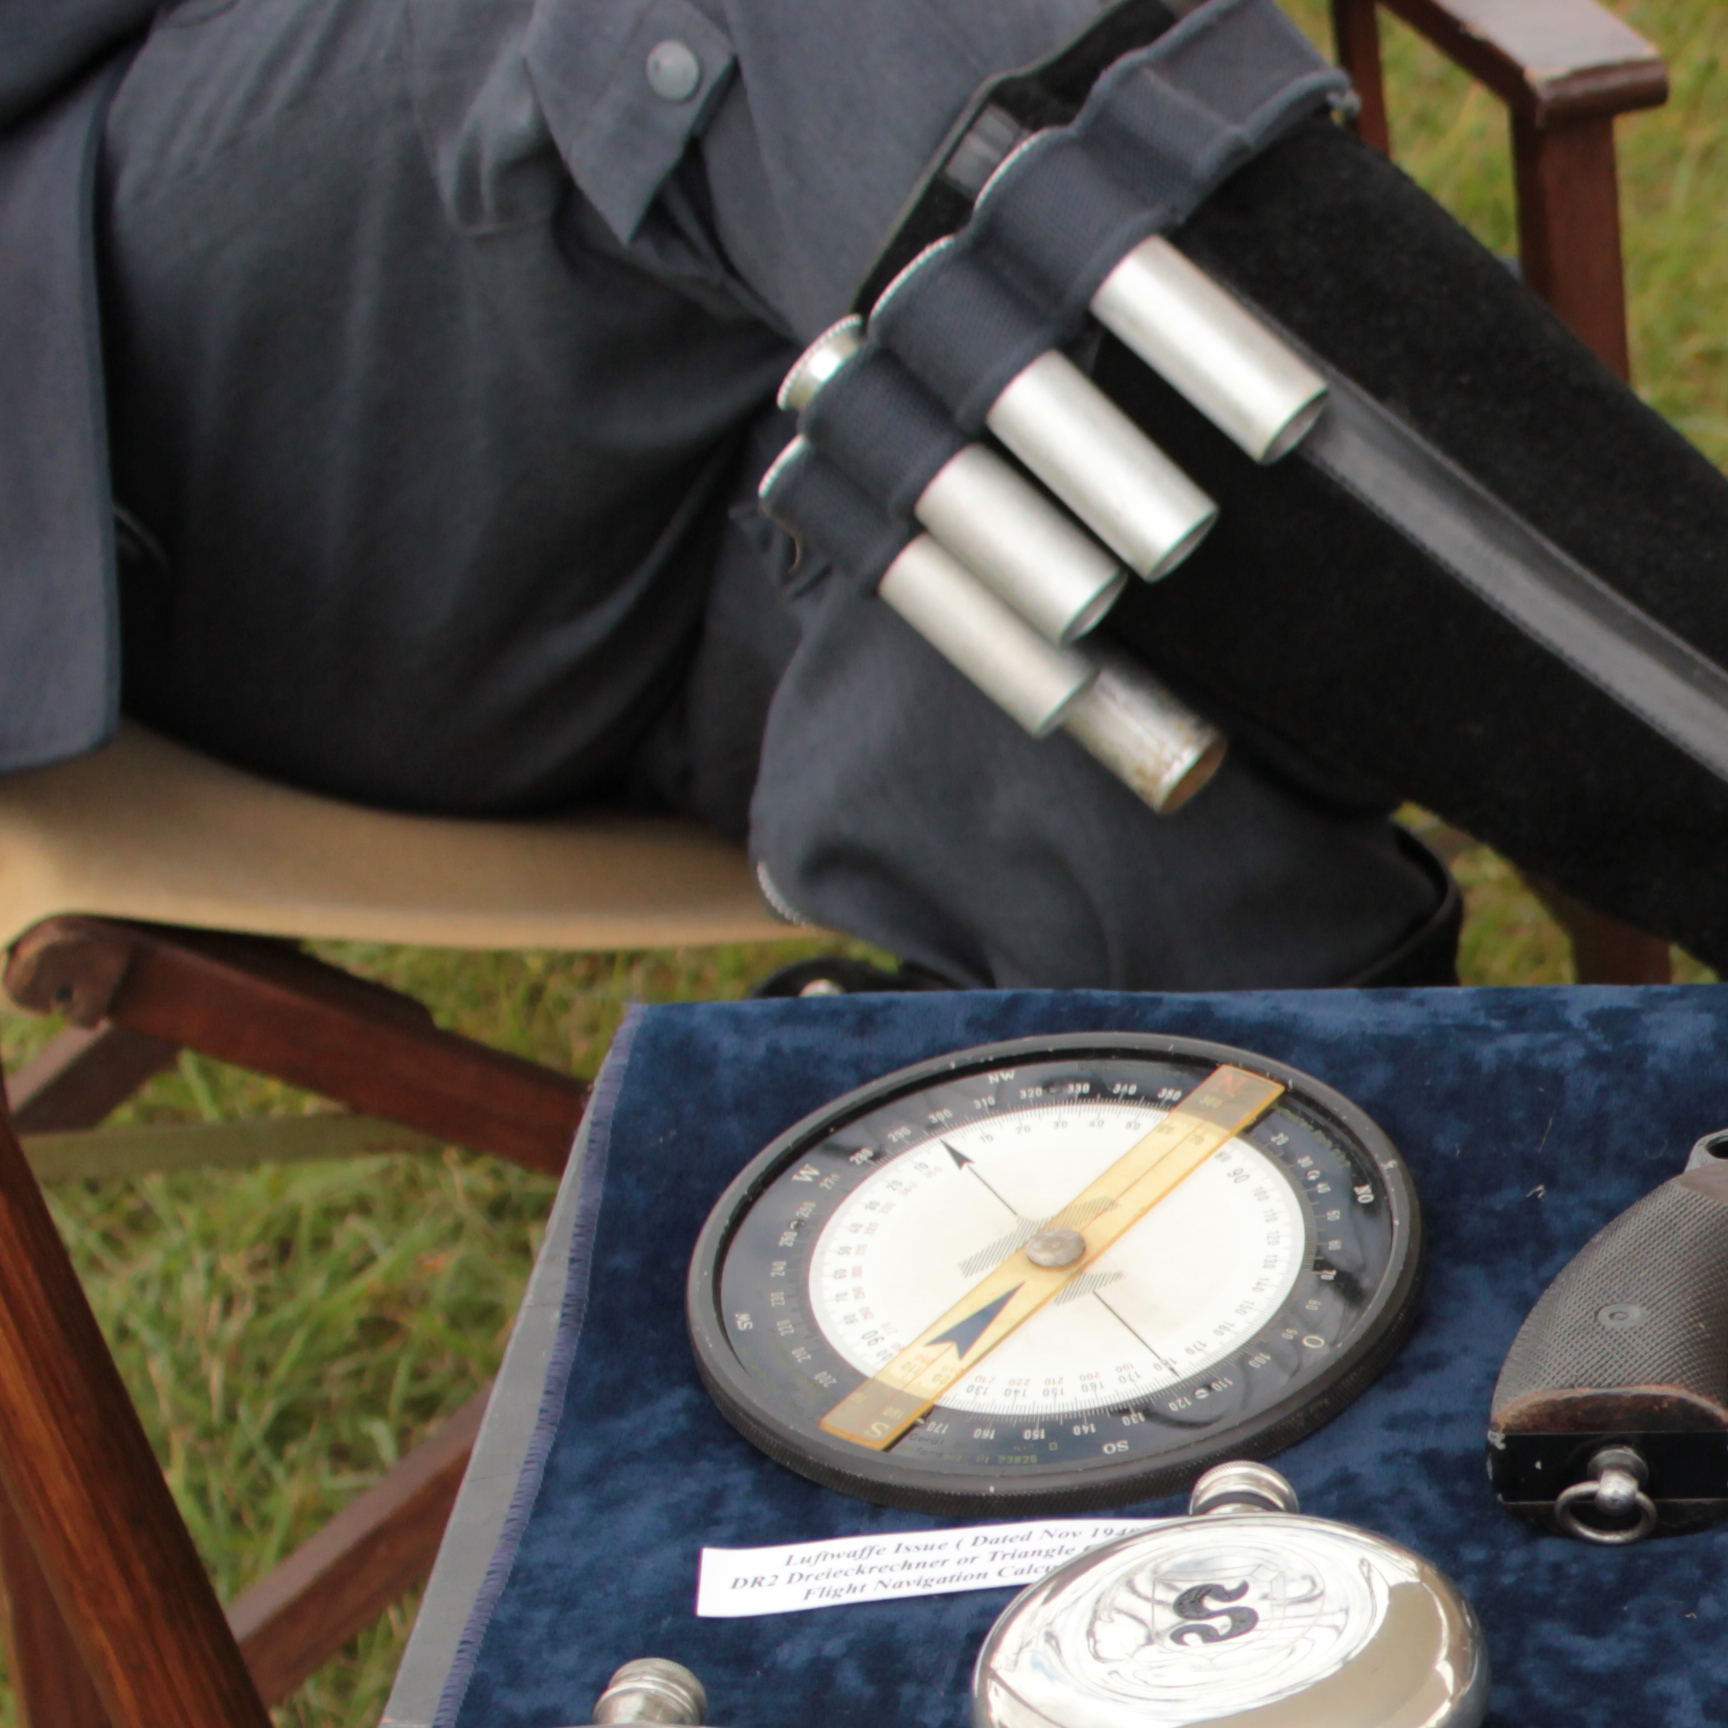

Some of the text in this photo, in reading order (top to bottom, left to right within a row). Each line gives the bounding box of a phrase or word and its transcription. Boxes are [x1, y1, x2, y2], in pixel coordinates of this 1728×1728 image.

[988, 1070, 1016, 1085] NW
[1019, 1086, 1043, 1099] 320
[1067, 1082, 1090, 1094] 330
[1157, 1089, 1182, 1102] 350
[973, 1096, 996, 1109] 310
[928, 1108, 952, 1125] 300
[792, 1164, 820, 1184] W
[1168, 1396, 1192, 1411] 120
[1122, 1411, 1146, 1426] 130
[864, 1422, 890, 1439] S
[925, 1421, 949, 1434] 170
[973, 1429, 995, 1440] 160
[1023, 1429, 1045, 1440] 150
[1073, 1423, 1095, 1436] 140
[1103, 1440, 1129, 1455] SO
[785, 1543, 887, 1566] Luftwaffe
[894, 1540, 948, 1553] Issue
[971, 1531, 1033, 1547] Dated
[1039, 1528, 1082, 1541] Nov
[731, 1575, 778, 1590] DR2
[942, 1556, 979, 1567] or
[988, 1545, 1075, 1563] Triangle
[803, 1583, 866, 1600] Flight
[874, 1571, 989, 1592] Navigation
